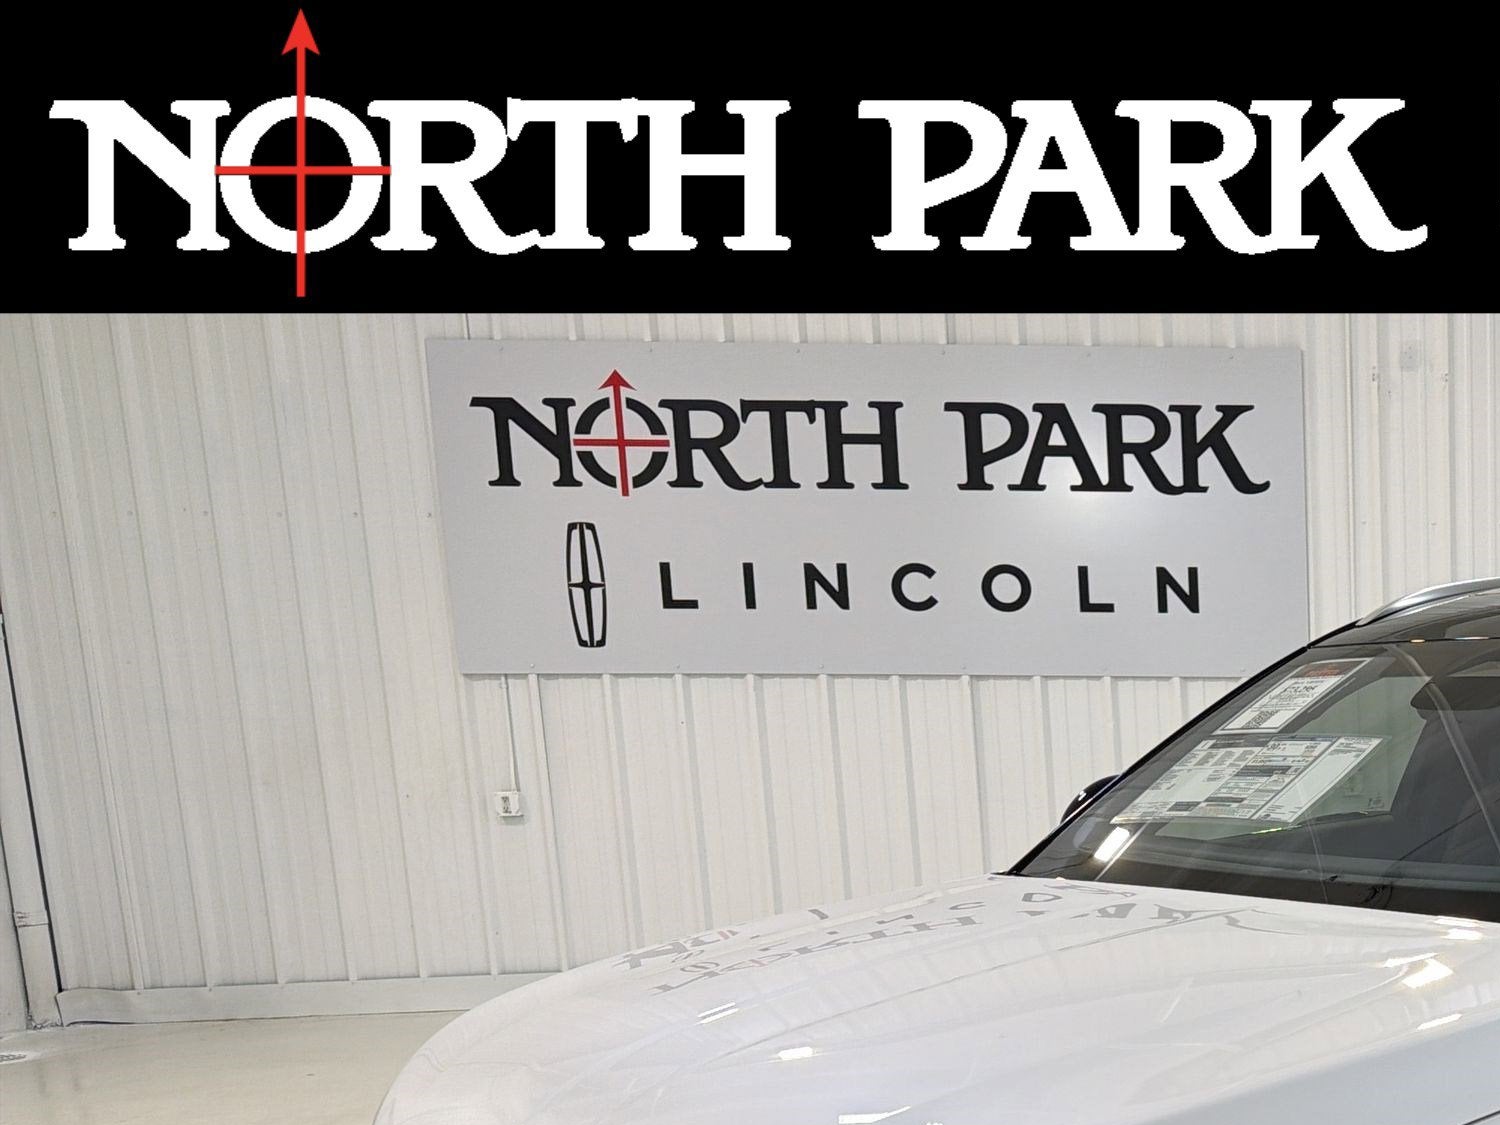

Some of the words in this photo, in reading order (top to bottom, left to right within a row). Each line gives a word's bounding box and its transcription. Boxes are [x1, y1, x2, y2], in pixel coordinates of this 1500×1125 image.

[469, 396, 909, 491] NORTH
[944, 401, 1271, 496] PARK
[659, 562, 1200, 613] LINCOLN
